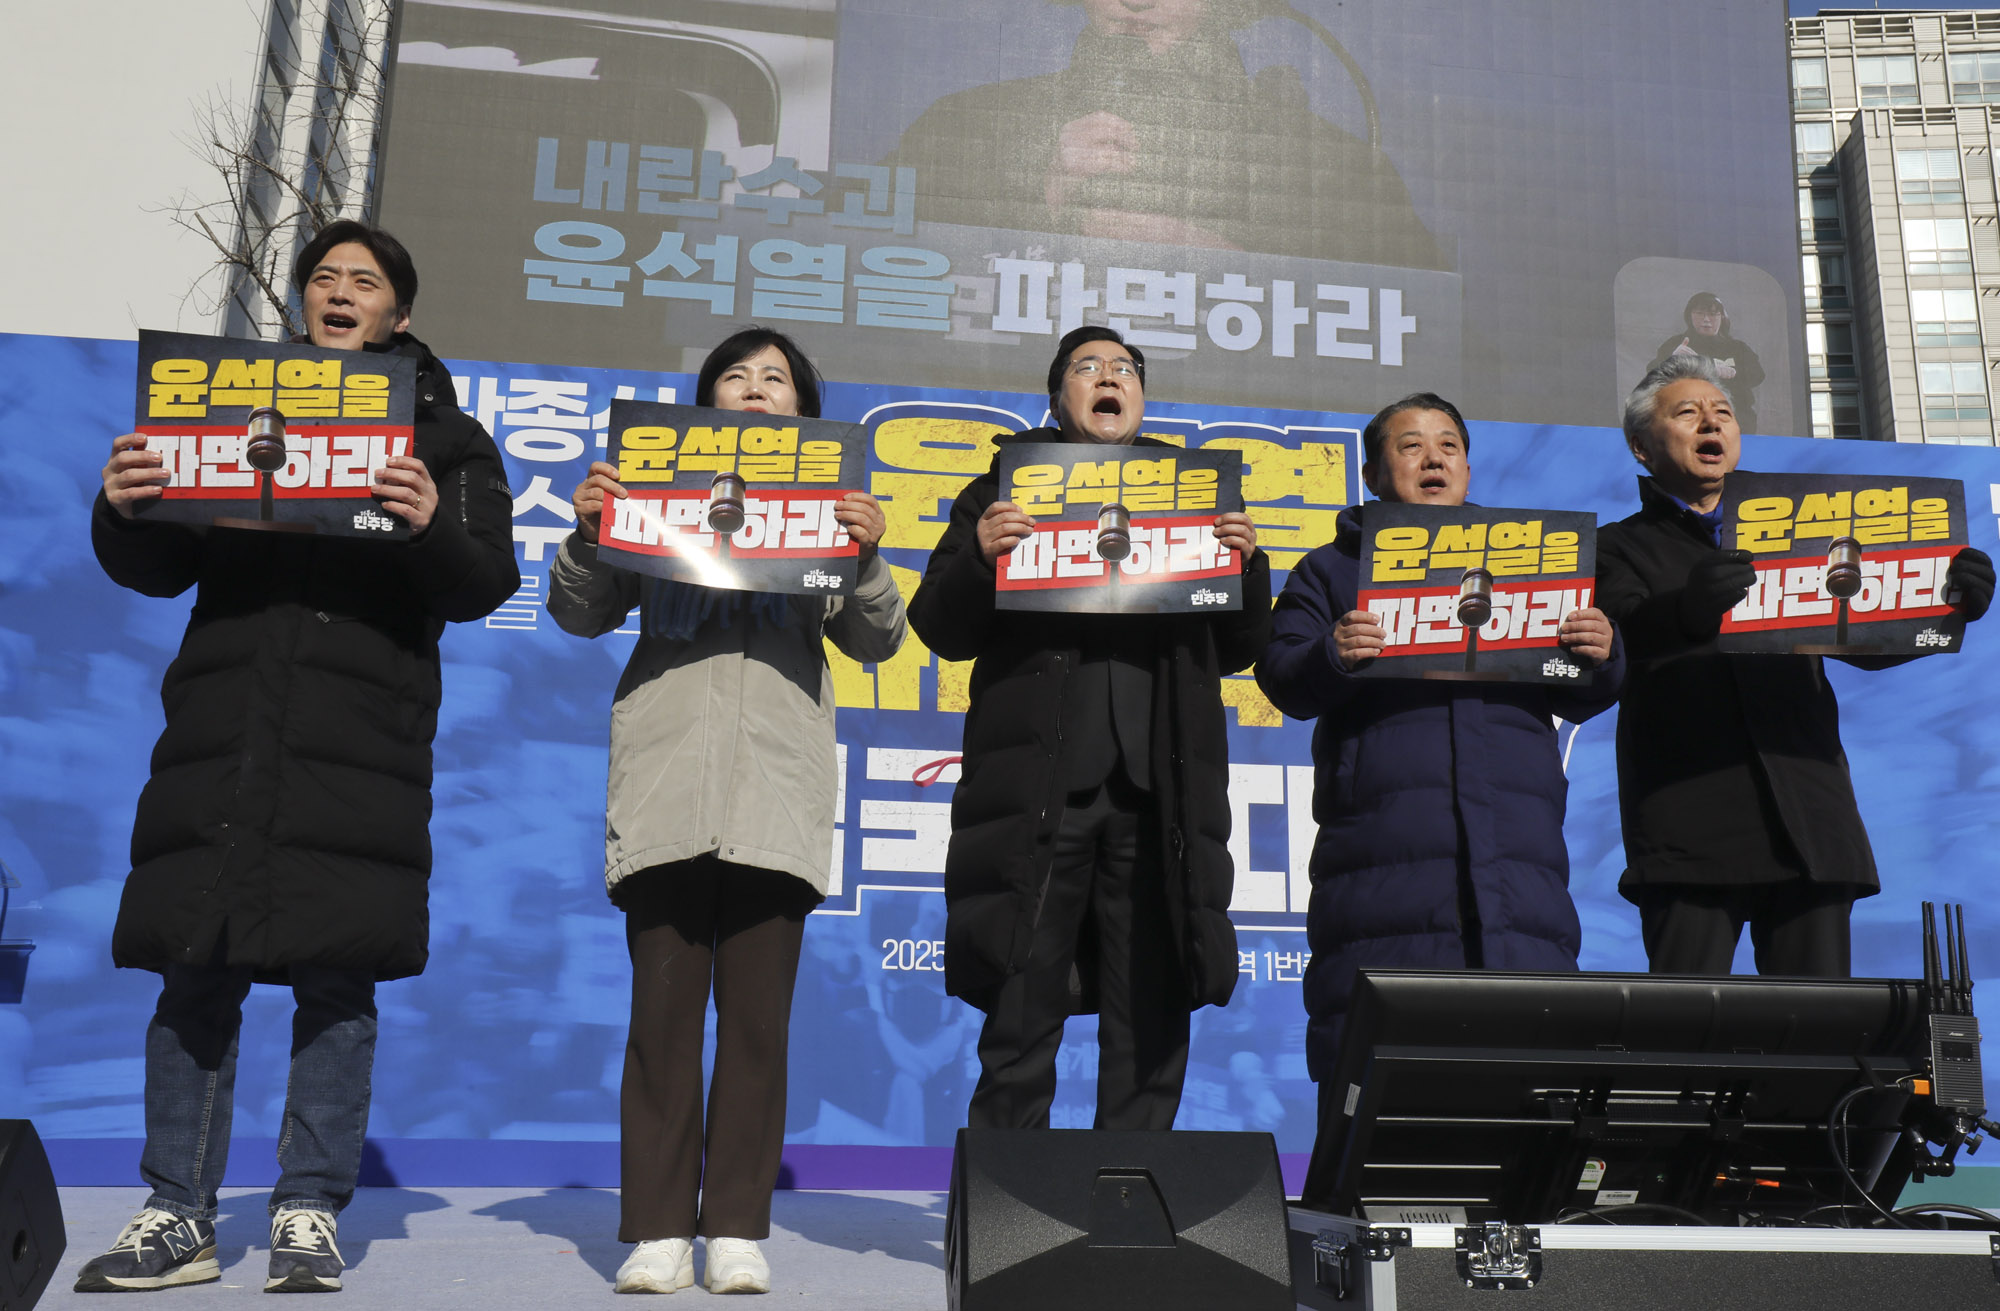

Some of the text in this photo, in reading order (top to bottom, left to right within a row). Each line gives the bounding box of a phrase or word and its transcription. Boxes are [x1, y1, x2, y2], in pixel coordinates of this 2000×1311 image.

[533, 137, 917, 235] 내란수괴
[523, 220, 956, 332] 윤석열을
[992, 257, 1416, 367] 파면하라
[148, 358, 390, 418] 윤석열을
[618, 426, 843, 483] 윤석열을
[1011, 458, 1219, 516] 윤석열을
[353, 514, 394, 532] 민주당
[1736, 486, 1950, 554] 윤석열을
[1371, 520, 1579, 583] 윤석열을
[803, 574, 843, 589] 민주당
[1191, 592, 1229, 606] 민주당
[1731, 555, 1961, 622] 파면하라
[1915, 633, 1952, 647] 민주당
[1542, 662, 1581, 678] 민주당
